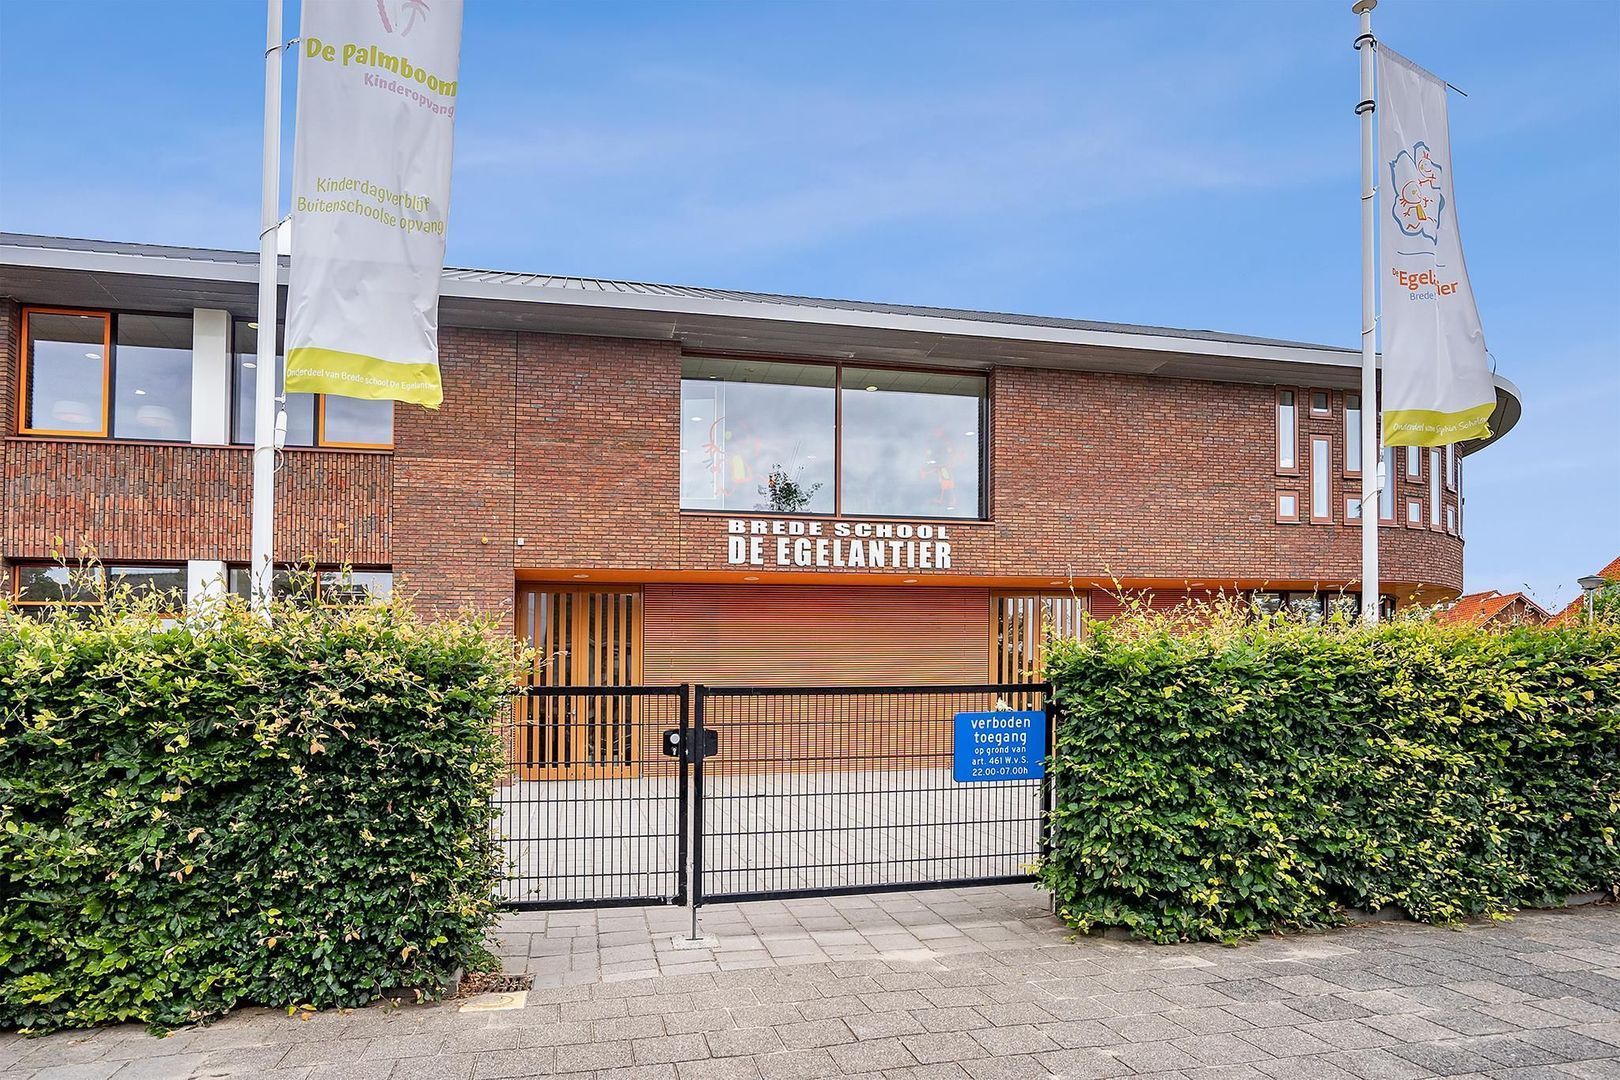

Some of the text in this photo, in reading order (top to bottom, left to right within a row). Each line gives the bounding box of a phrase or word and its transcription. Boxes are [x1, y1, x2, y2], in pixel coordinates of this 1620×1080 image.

[306, 37, 458, 97] De Palmboom
[364, 72, 454, 118] Kinderopvang
[316, 177, 431, 213] Kinderdagverblijf
[297, 197, 444, 236] Buitenschoolse opvang
[1409, 291, 1434, 301] Brede
[287, 367, 324, 378] Onderdeel
[325, 370, 340, 379] van
[341, 371, 365, 384] Brede
[365, 376, 389, 388] school
[728, 519, 950, 540] BREDE SCHOOL
[728, 536, 951, 569] DE EGELANTIER
[971, 716, 1031, 730] verboden
[974, 731, 1027, 746] toegang
[972, 755, 1029, 766] art. 461 W.v.S.
[974, 748, 985, 756] op
[986, 746, 1009, 756] grond
